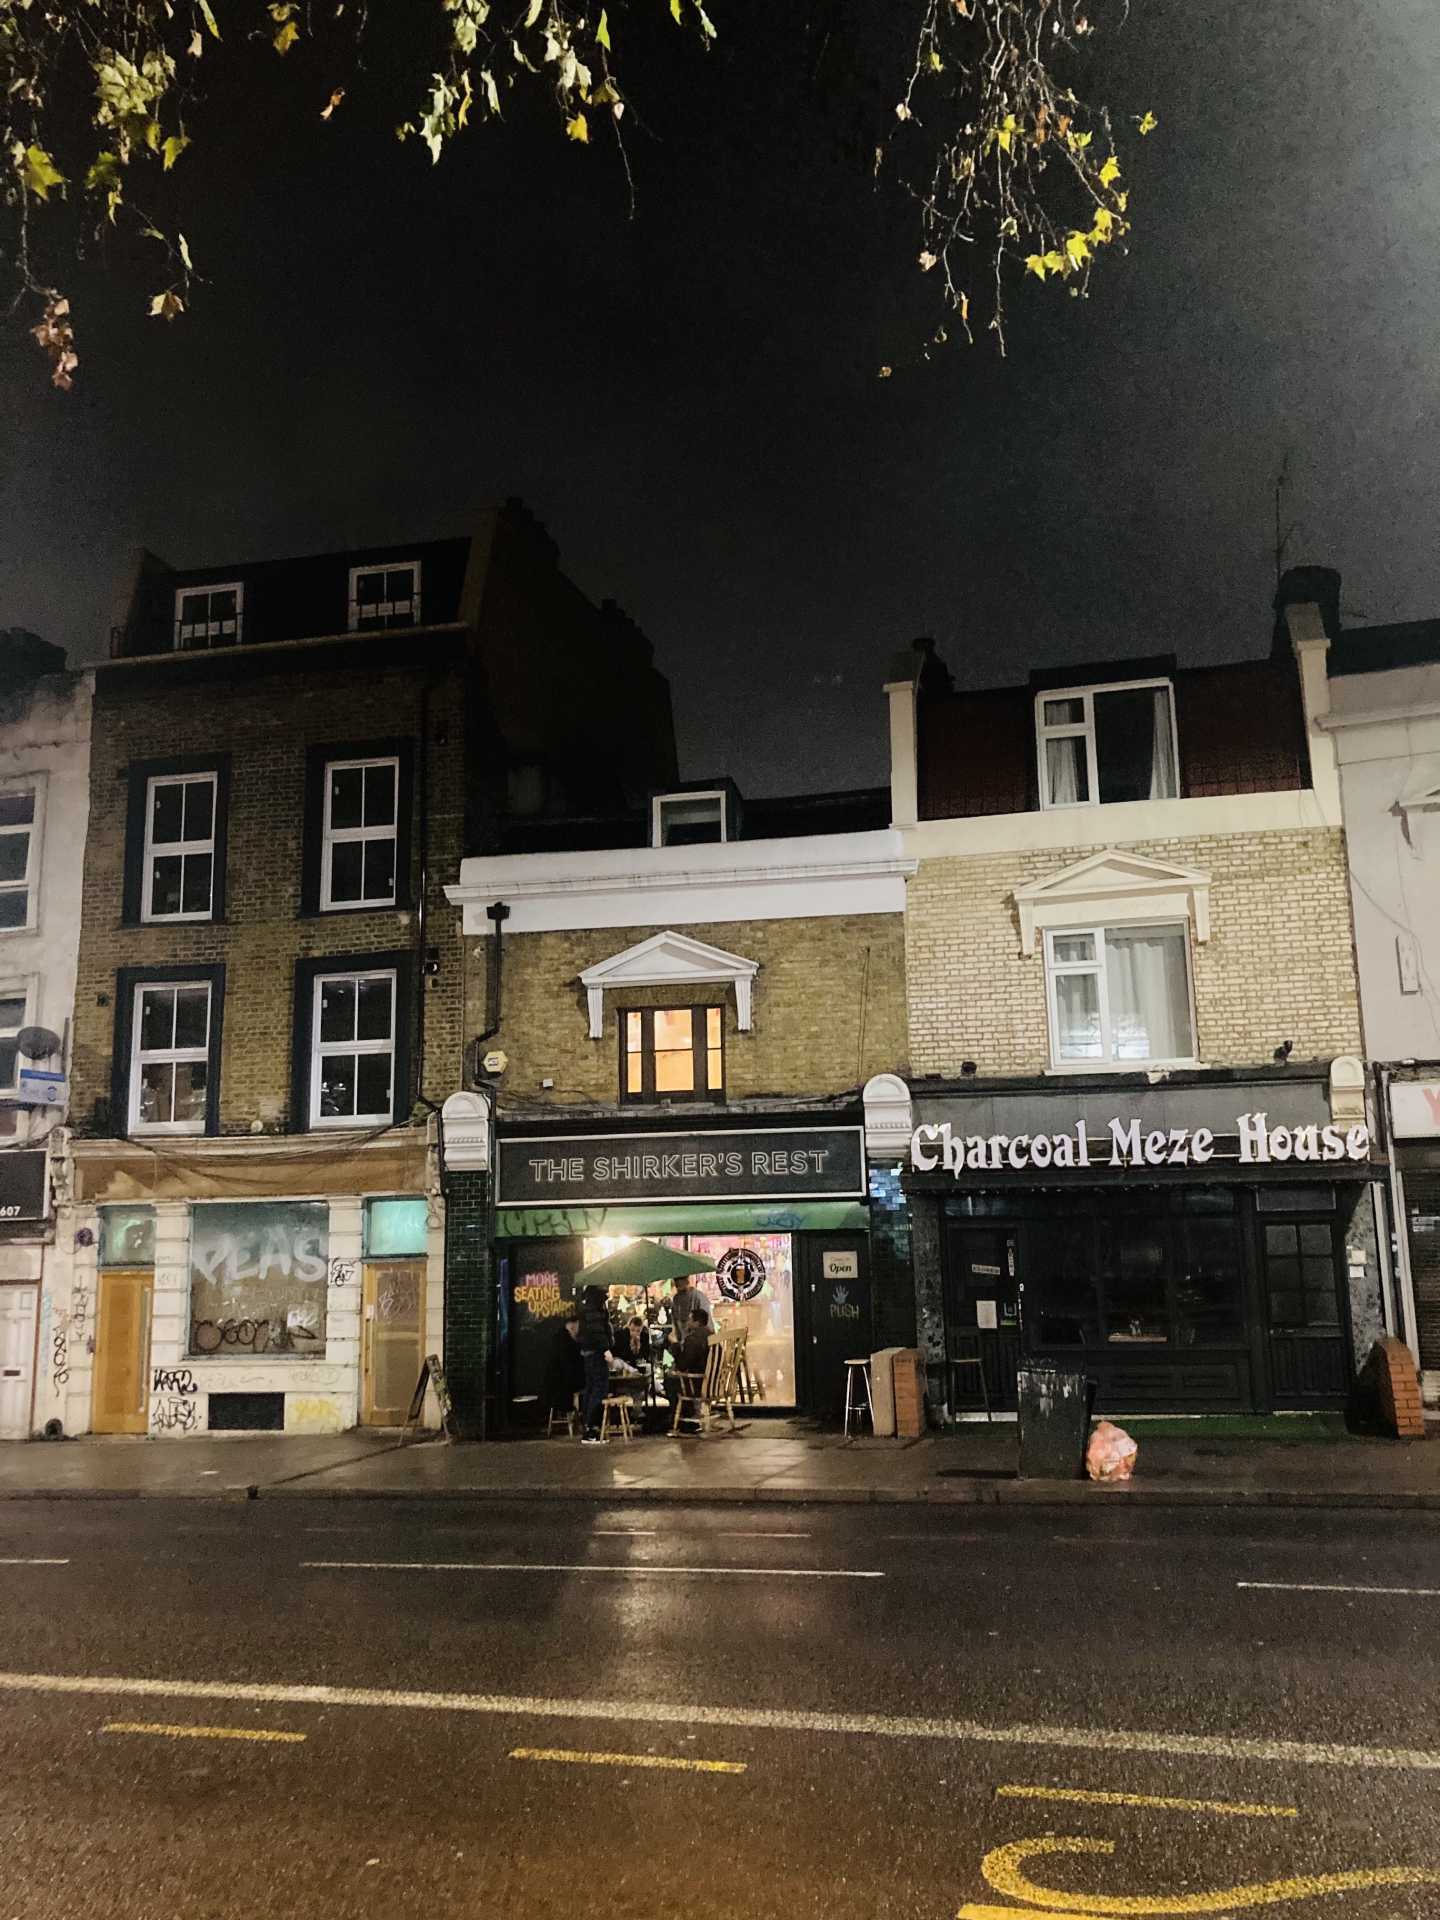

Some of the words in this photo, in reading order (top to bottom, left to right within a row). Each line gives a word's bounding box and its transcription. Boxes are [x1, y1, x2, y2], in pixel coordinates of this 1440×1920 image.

[911, 1118, 1091, 1180] Charcoal
[1107, 1116, 1214, 1168] Meze
[1236, 1112, 1370, 1163] House
[529, 1158, 584, 1182] THE
[592, 1152, 743, 1181] SHIRKER'S
[752, 1150, 829, 1176] REST
[830, 1263, 852, 1275] Open
[525, 1271, 560, 1287] MORE
[514, 1285, 561, 1303] SEATING
[830, 1304, 860, 1320] PUSH
